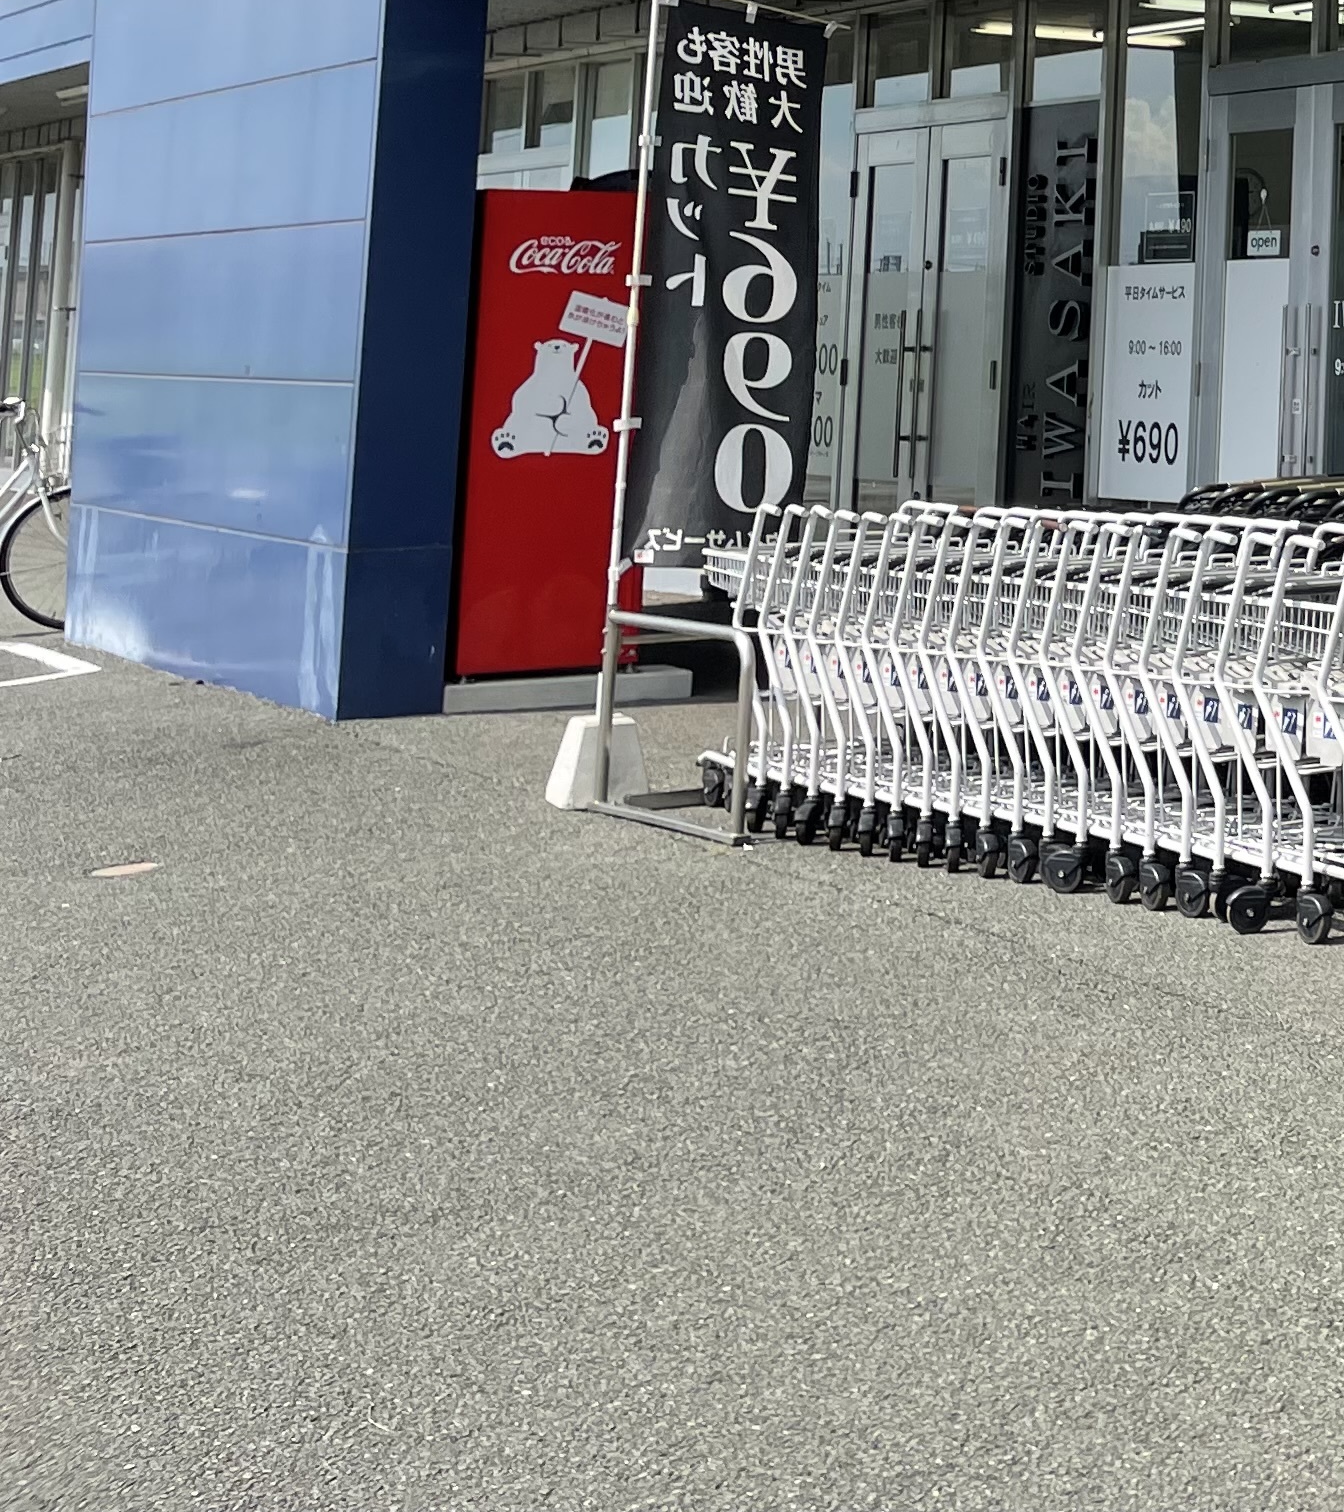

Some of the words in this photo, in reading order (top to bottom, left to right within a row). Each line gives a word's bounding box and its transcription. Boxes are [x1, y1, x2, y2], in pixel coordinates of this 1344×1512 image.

[1250, 236, 1278, 252] open
[509, 239, 622, 274] Coca-Cola
[1125, 285, 1186, 301] 平日タイムサービス
[1040, 138, 1098, 498] IWASAKI
[1128, 340, 1147, 356] 9:00
[1158, 340, 1182, 356] 16:00
[1138, 379, 1162, 400] カット
[1118, 419, 1179, 465] ¥690
